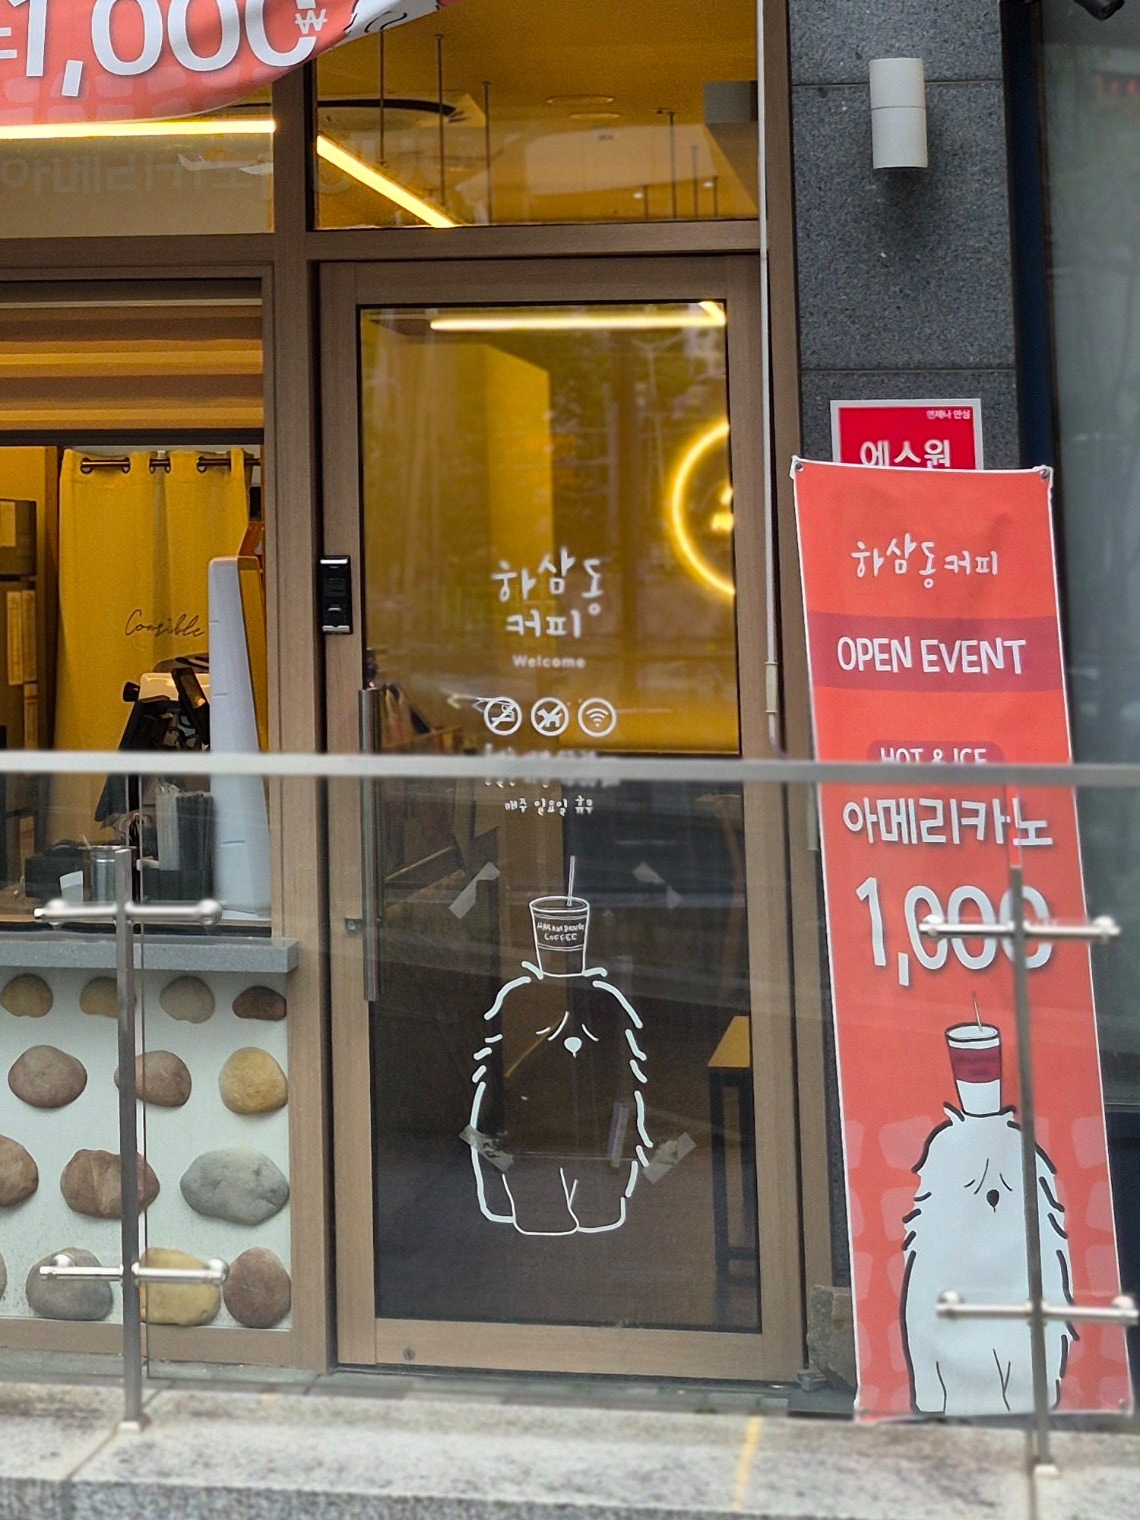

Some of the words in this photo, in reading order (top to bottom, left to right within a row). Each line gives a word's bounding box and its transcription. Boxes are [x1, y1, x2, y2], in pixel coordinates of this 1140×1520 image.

[491, 546, 605, 616] 하삼동
[506, 609, 582, 638] 커피
[512, 655, 586, 669] Welcome
[837, 635, 912, 673] OPEN
[920, 637, 1027, 675] EVENT
[843, 796, 1053, 845] 아메리카노
[544, 932, 578, 942] COFFEE
